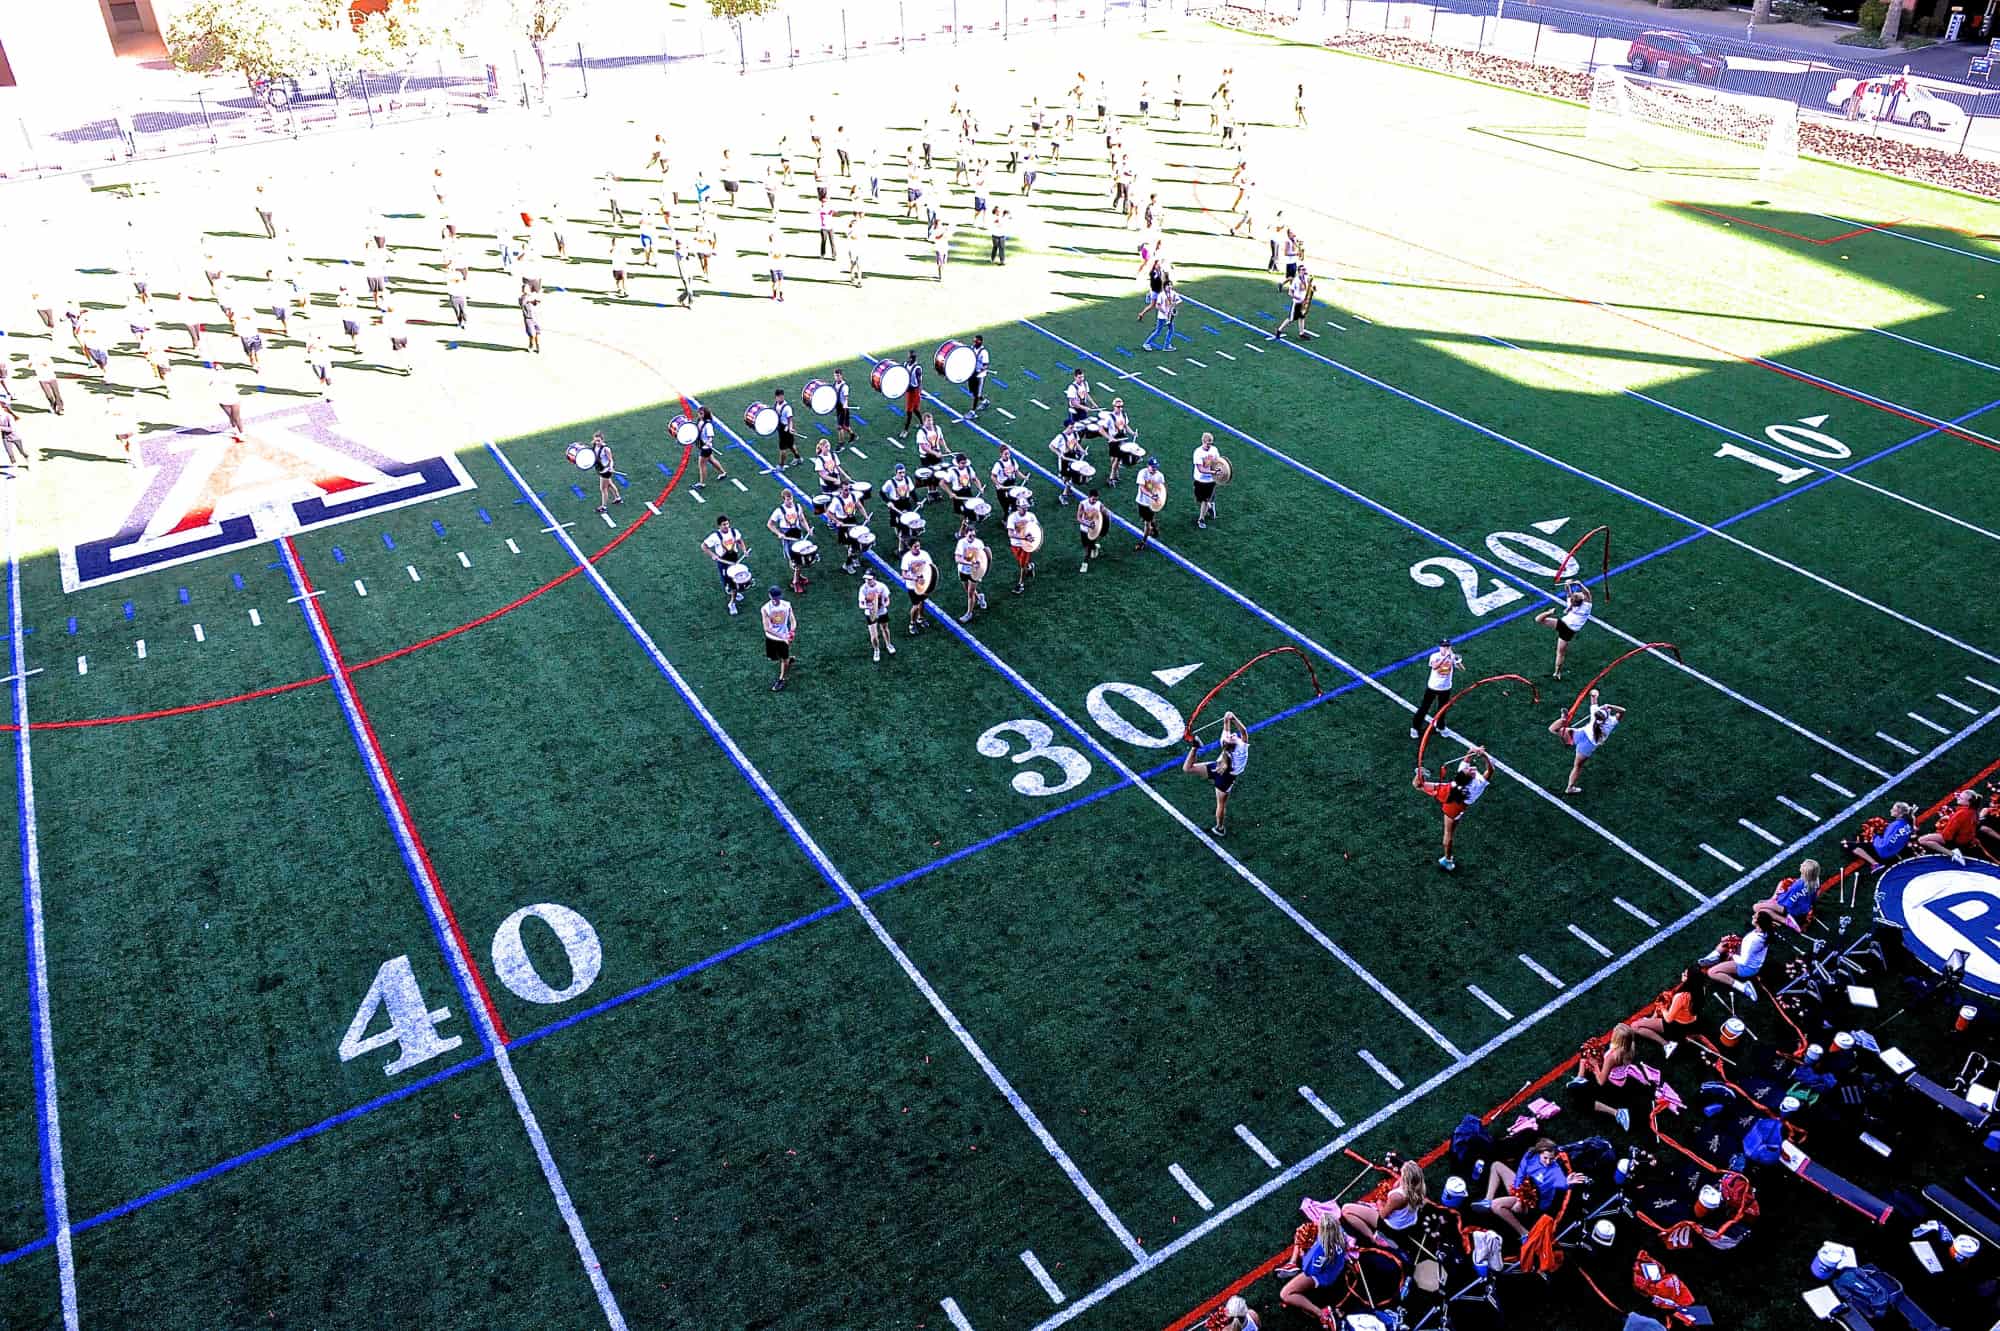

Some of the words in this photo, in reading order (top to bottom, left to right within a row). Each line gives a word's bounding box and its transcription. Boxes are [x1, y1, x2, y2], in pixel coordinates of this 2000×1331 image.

[1713, 425, 1852, 484] 10
[1410, 531, 1579, 617] 20
[977, 682, 1187, 796] 30
[338, 902, 603, 1076] 40
[1667, 1225, 1690, 1247] 40
